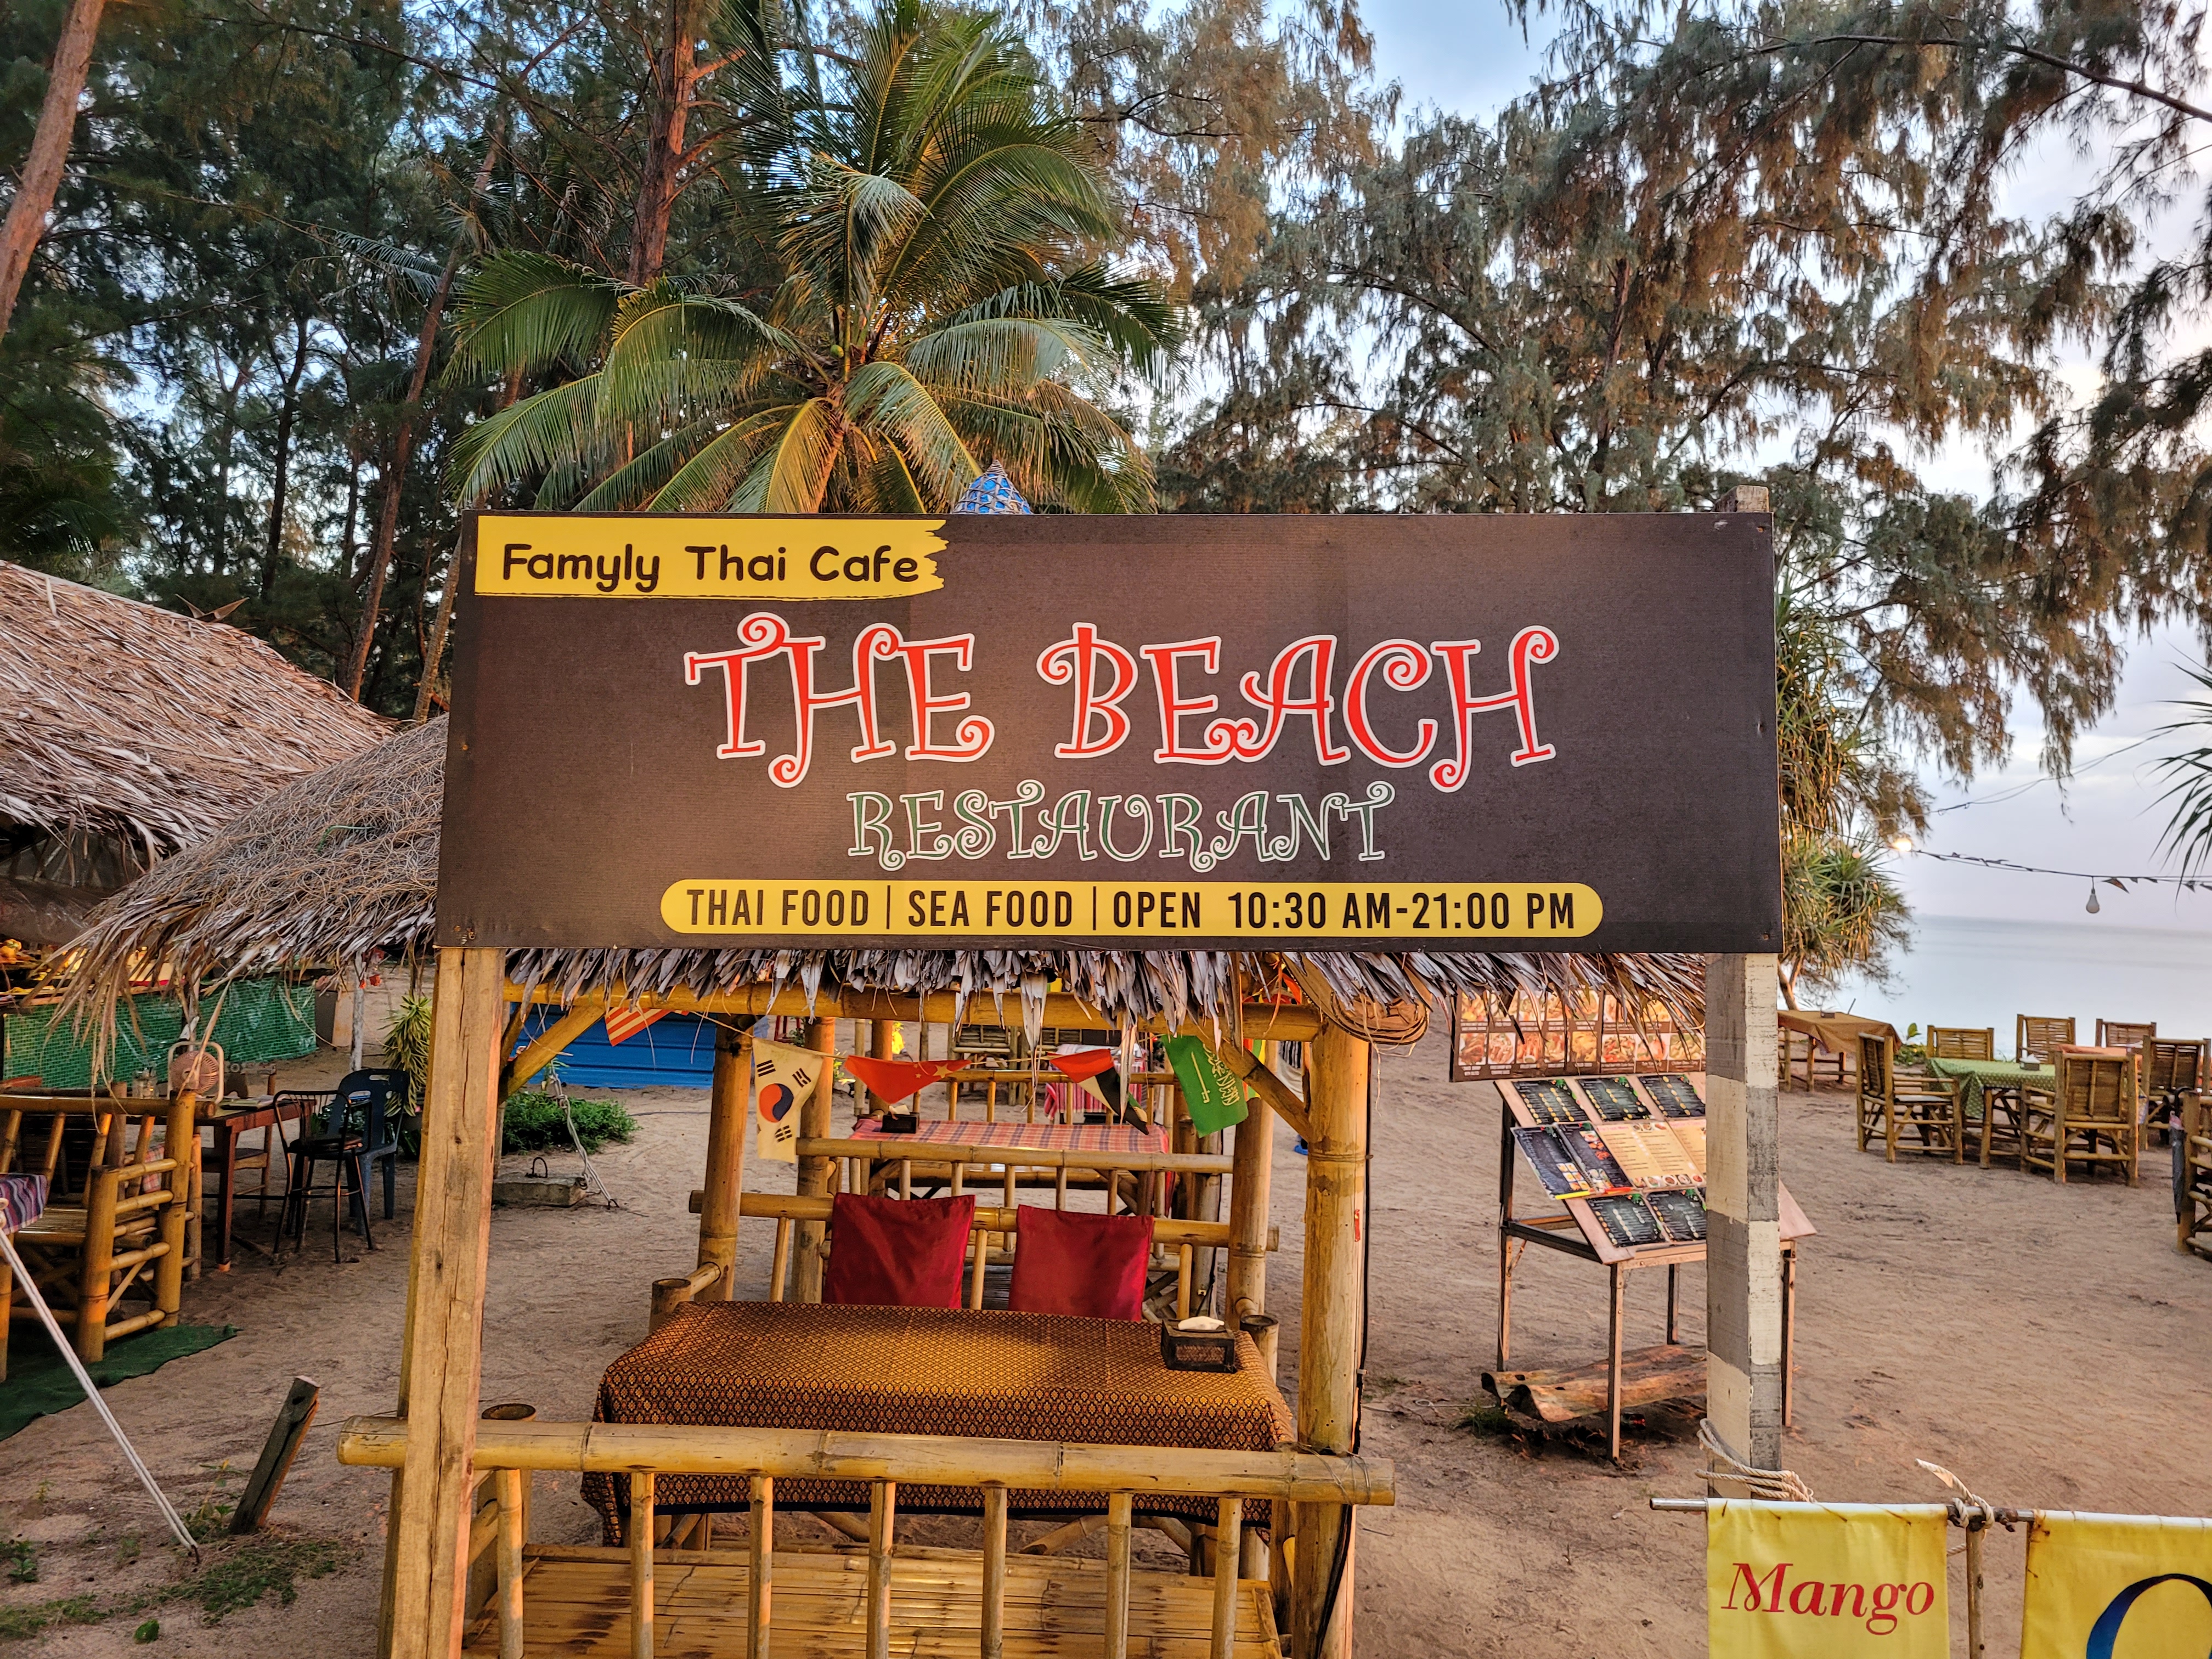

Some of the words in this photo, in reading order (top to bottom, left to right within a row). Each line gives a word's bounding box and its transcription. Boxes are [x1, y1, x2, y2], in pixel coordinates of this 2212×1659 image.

[503, 543, 660, 593] Famyly
[685, 544, 786, 582] Thai
[810, 545, 919, 583] Cafe
[684, 612, 995, 788] THE
[1036, 622, 1560, 793] BEACH
[846, 779, 1396, 873] RESTAURANT
[687, 889, 763, 926] THAI
[782, 890, 868, 927] FOOD
[909, 890, 969, 927] SEA
[986, 890, 1072, 928] FOOD
[1114, 891, 1200, 928] OPEN
[1228, 891, 1326, 929] 10:30
[1527, 893, 1574, 929] PM
[1721, 1563, 1934, 1635] Mango
